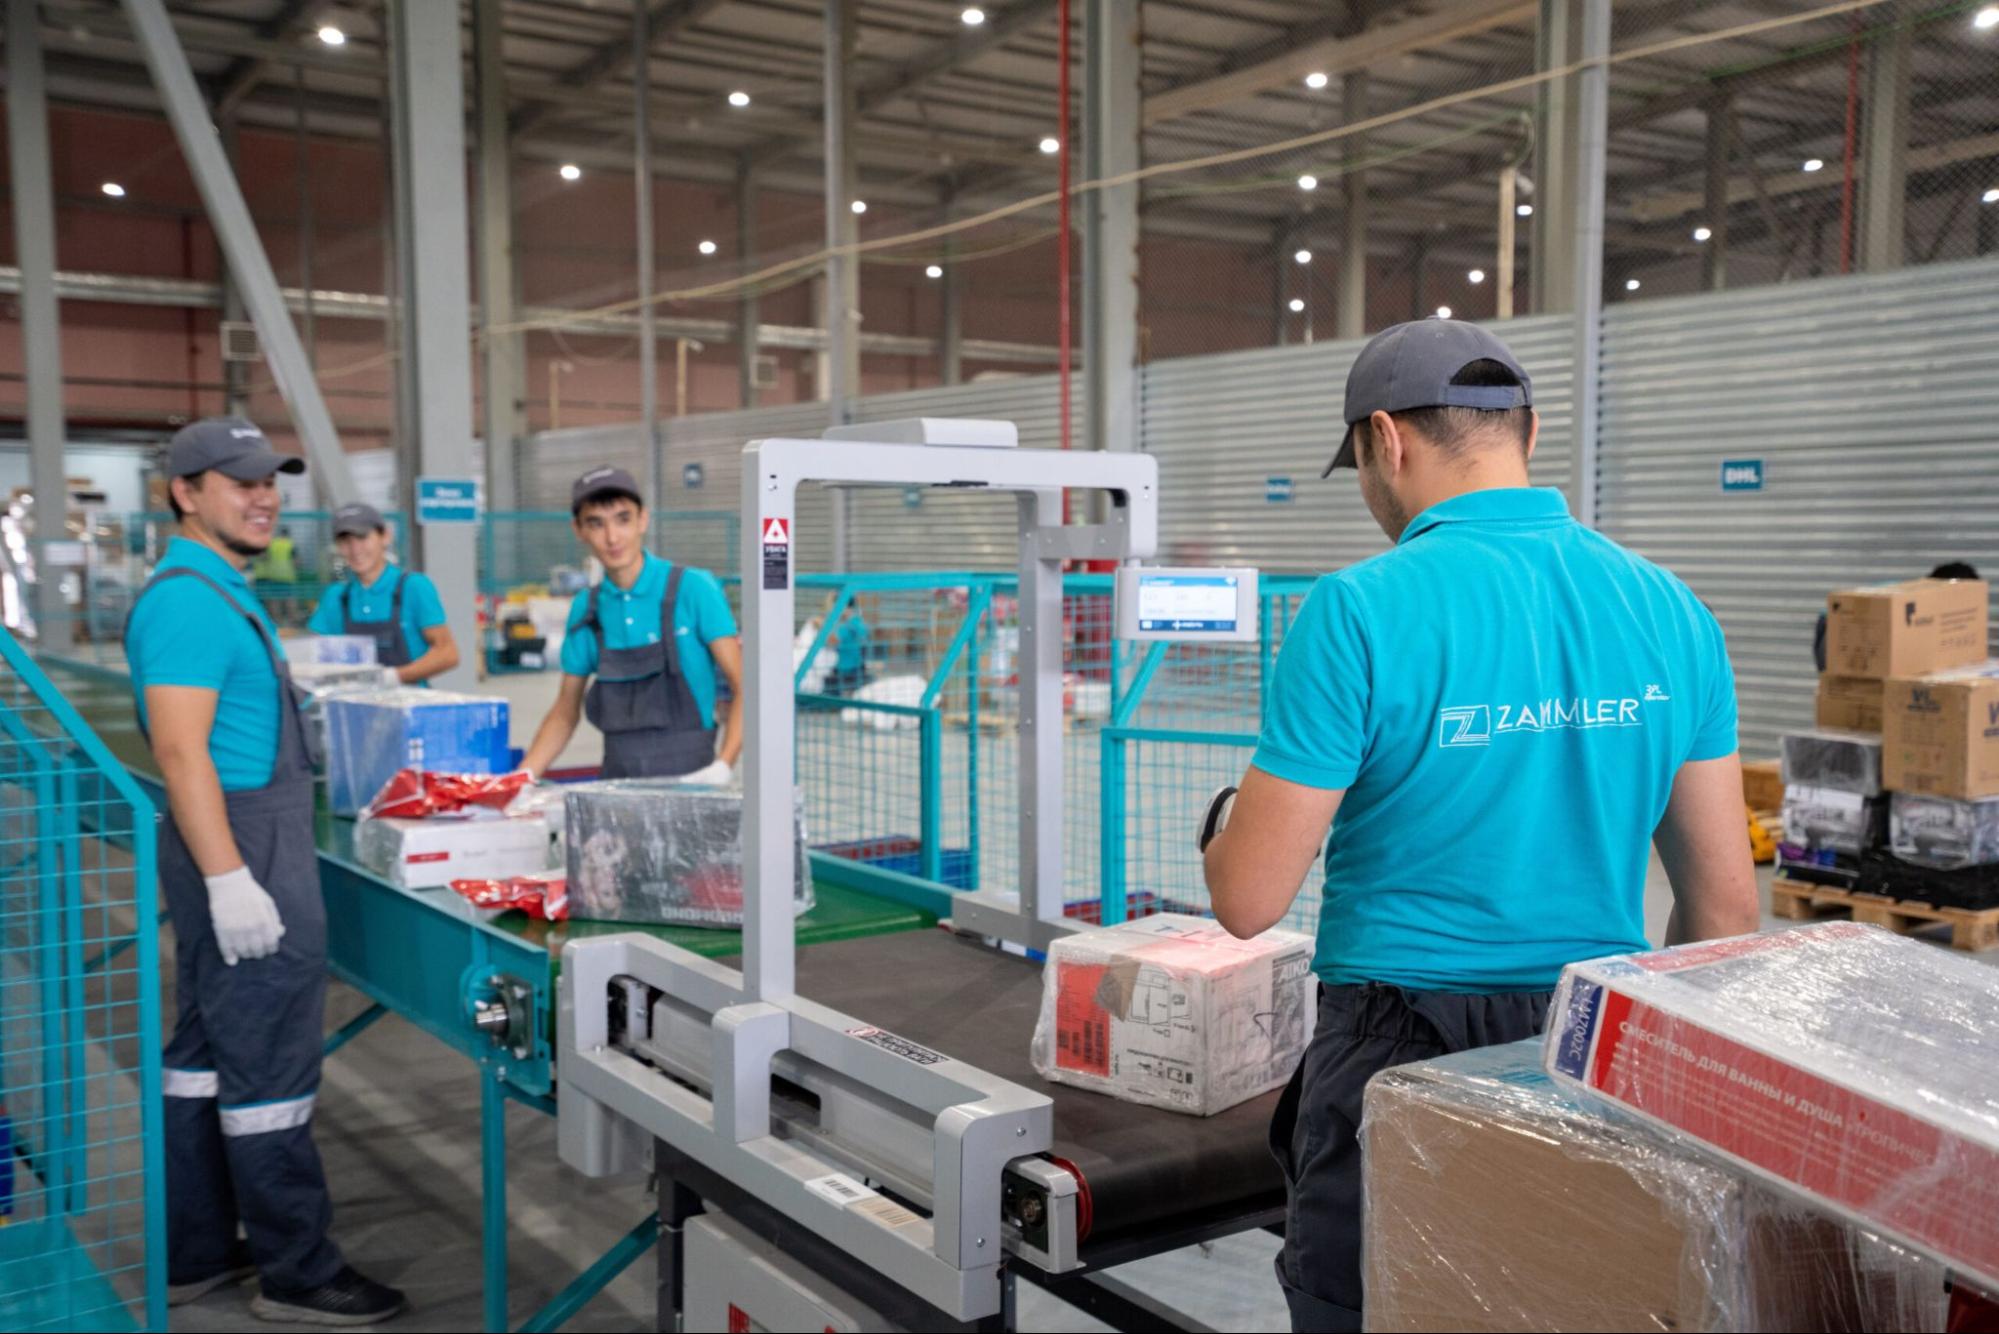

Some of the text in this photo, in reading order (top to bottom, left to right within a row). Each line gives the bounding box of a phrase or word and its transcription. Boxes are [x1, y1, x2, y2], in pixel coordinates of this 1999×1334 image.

[1618, 1021, 1696, 1064] СМЕСИТЕЛЬ
[1697, 1055, 1728, 1077] ДЛЯ
[1728, 1068, 1782, 1102] ВАННЫ
[1783, 1092, 1796, 1107] И
[1796, 1099, 1843, 1128] ДУША
